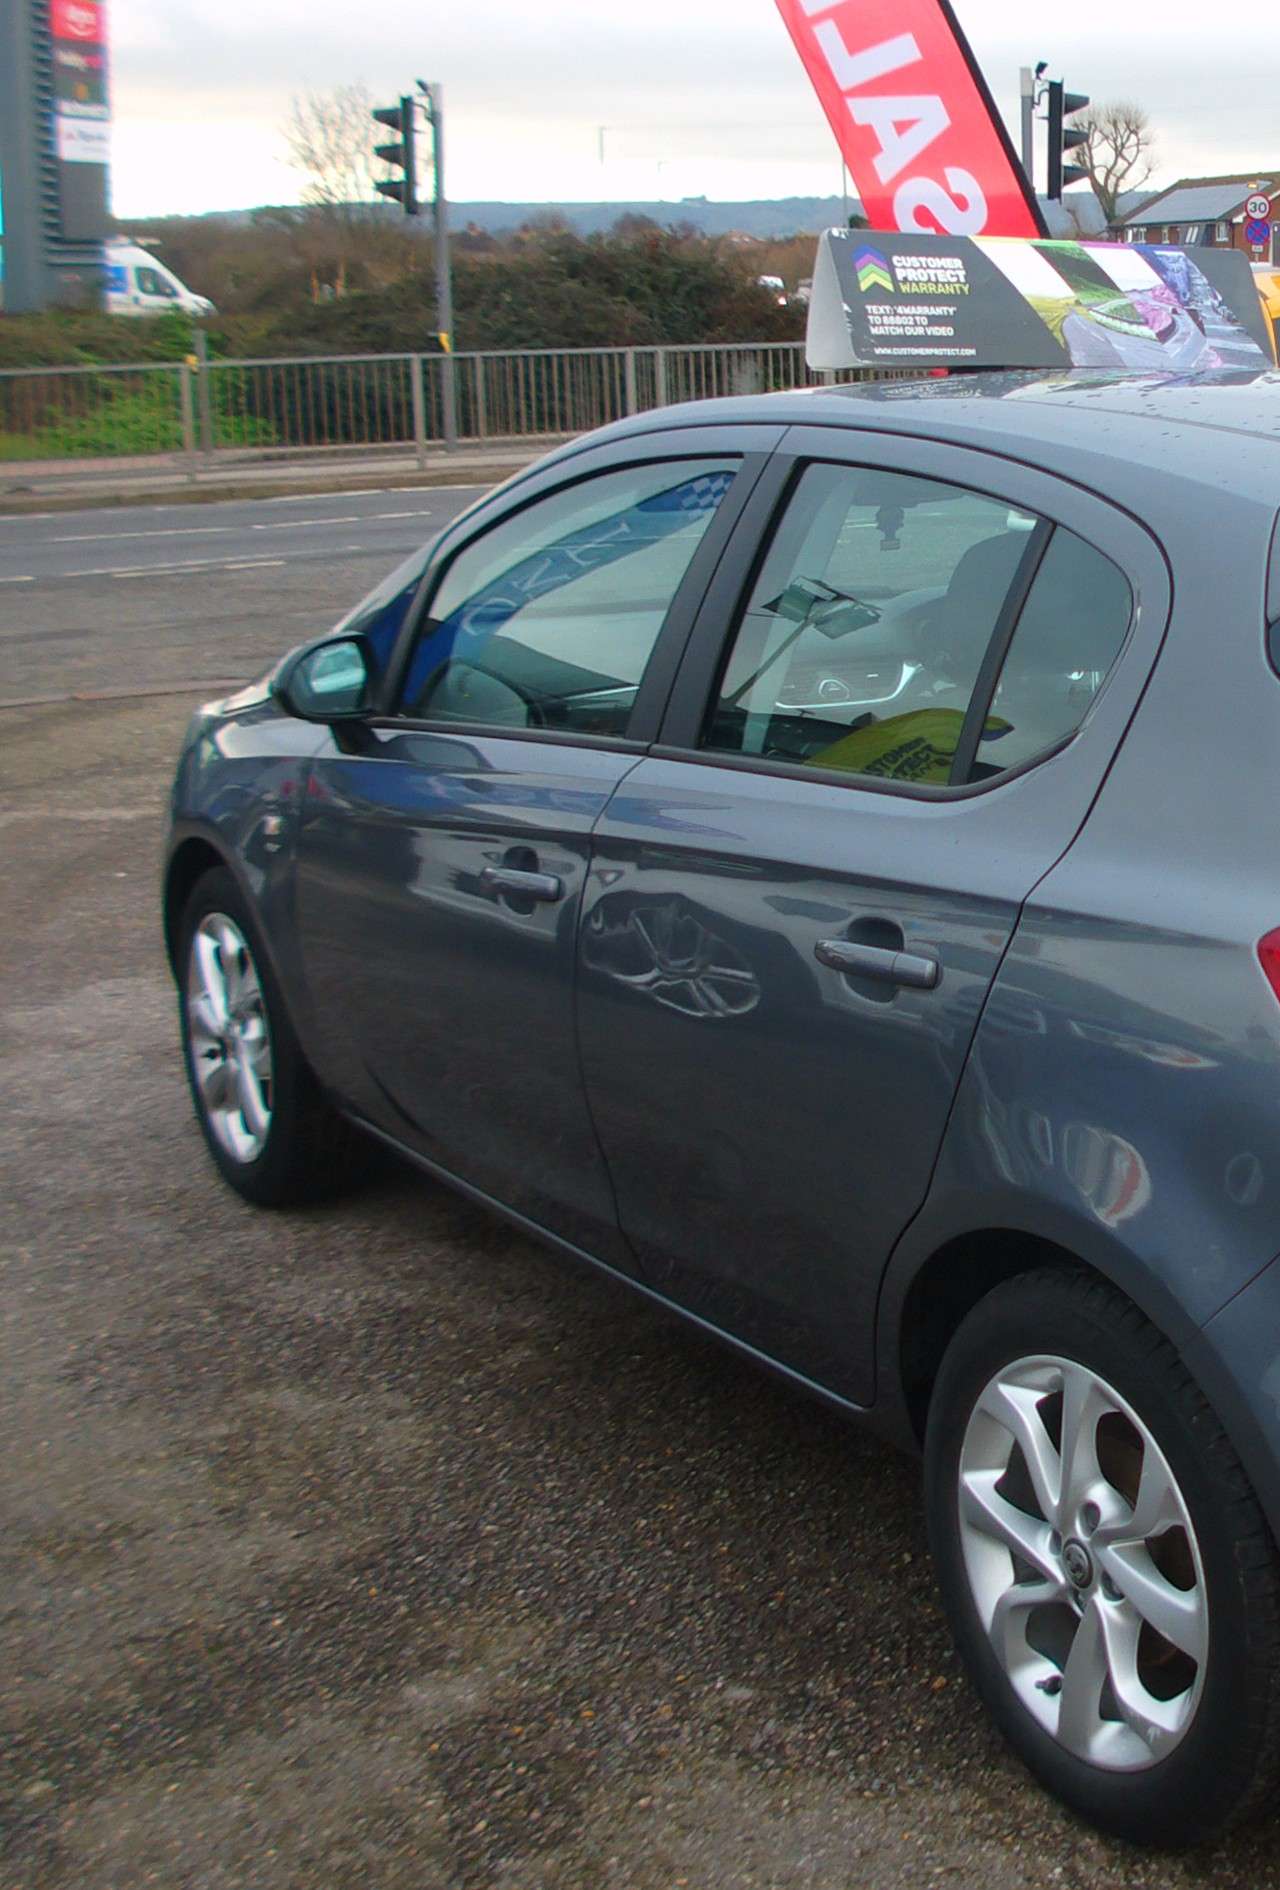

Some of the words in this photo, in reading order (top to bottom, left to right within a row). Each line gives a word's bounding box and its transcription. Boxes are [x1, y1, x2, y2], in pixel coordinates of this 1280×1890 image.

[1249, 201, 1267, 214] 30
[891, 255, 964, 269] CUSTOMER
[894, 268, 966, 283] PROTECT
[898, 282, 970, 295] WARRANTY
[926, 326, 955, 337] VIDEO
